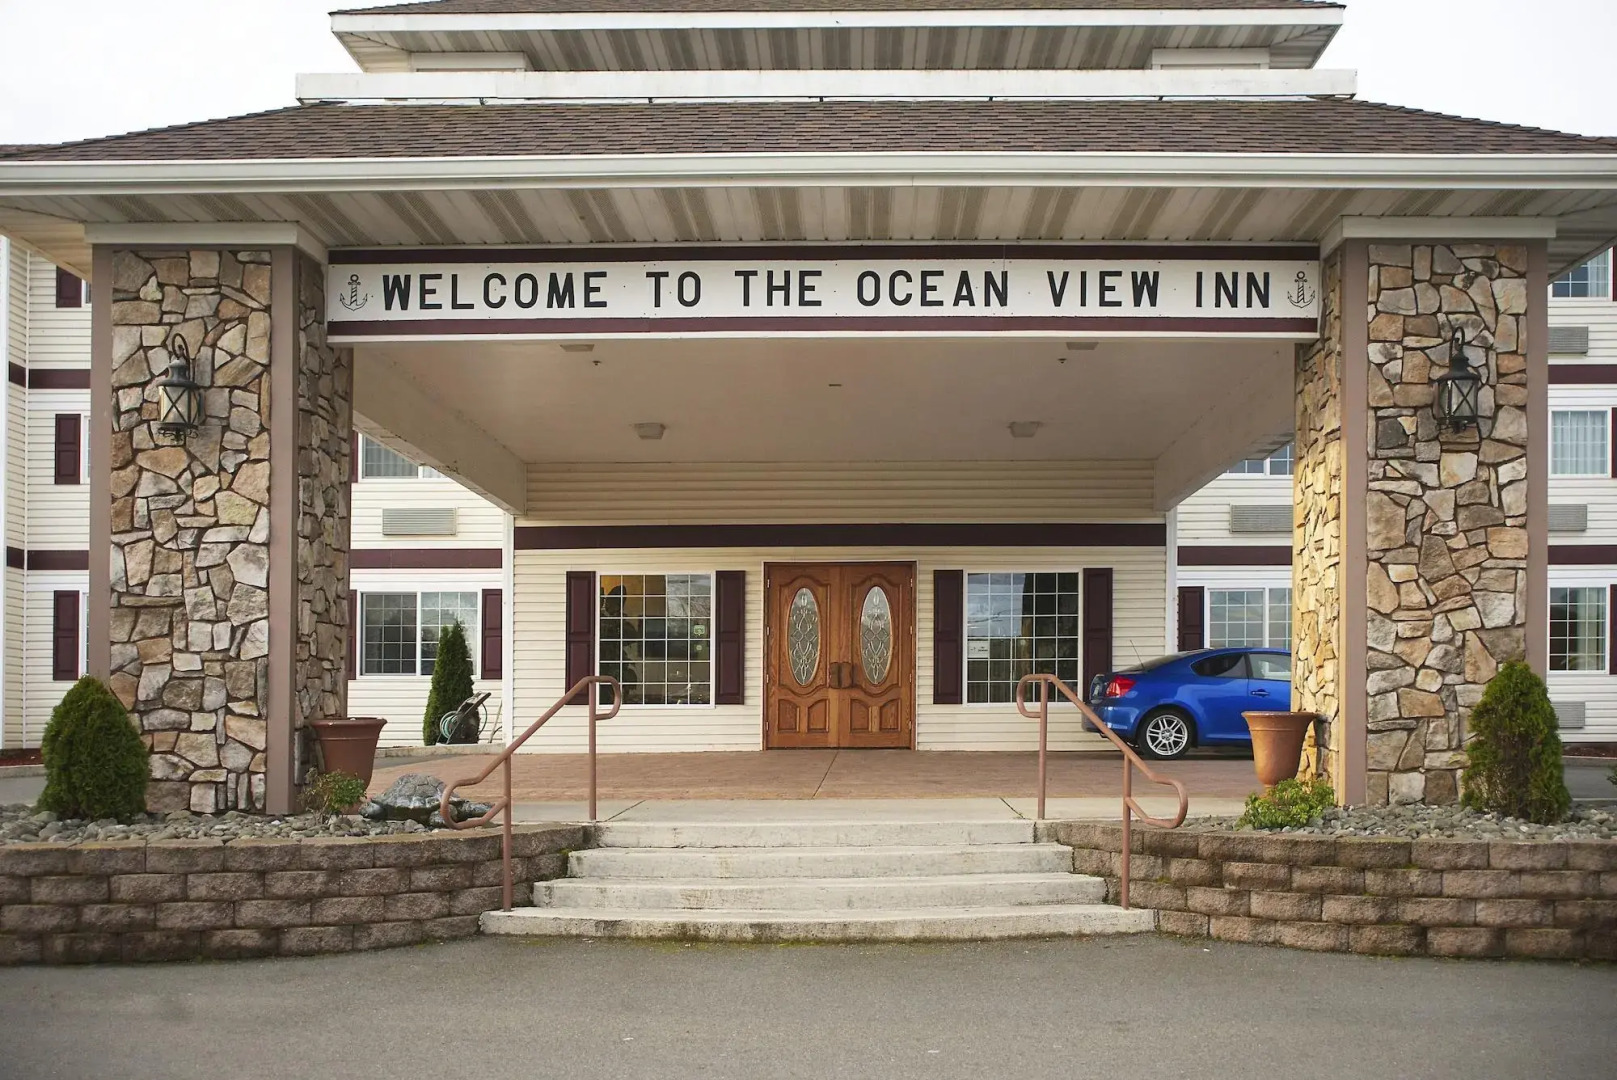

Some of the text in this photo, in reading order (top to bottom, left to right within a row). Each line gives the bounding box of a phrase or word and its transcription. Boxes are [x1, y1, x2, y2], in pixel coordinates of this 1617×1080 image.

[382, 269, 1271, 311] WELCOME TO THE OCEAN VIEW INN
